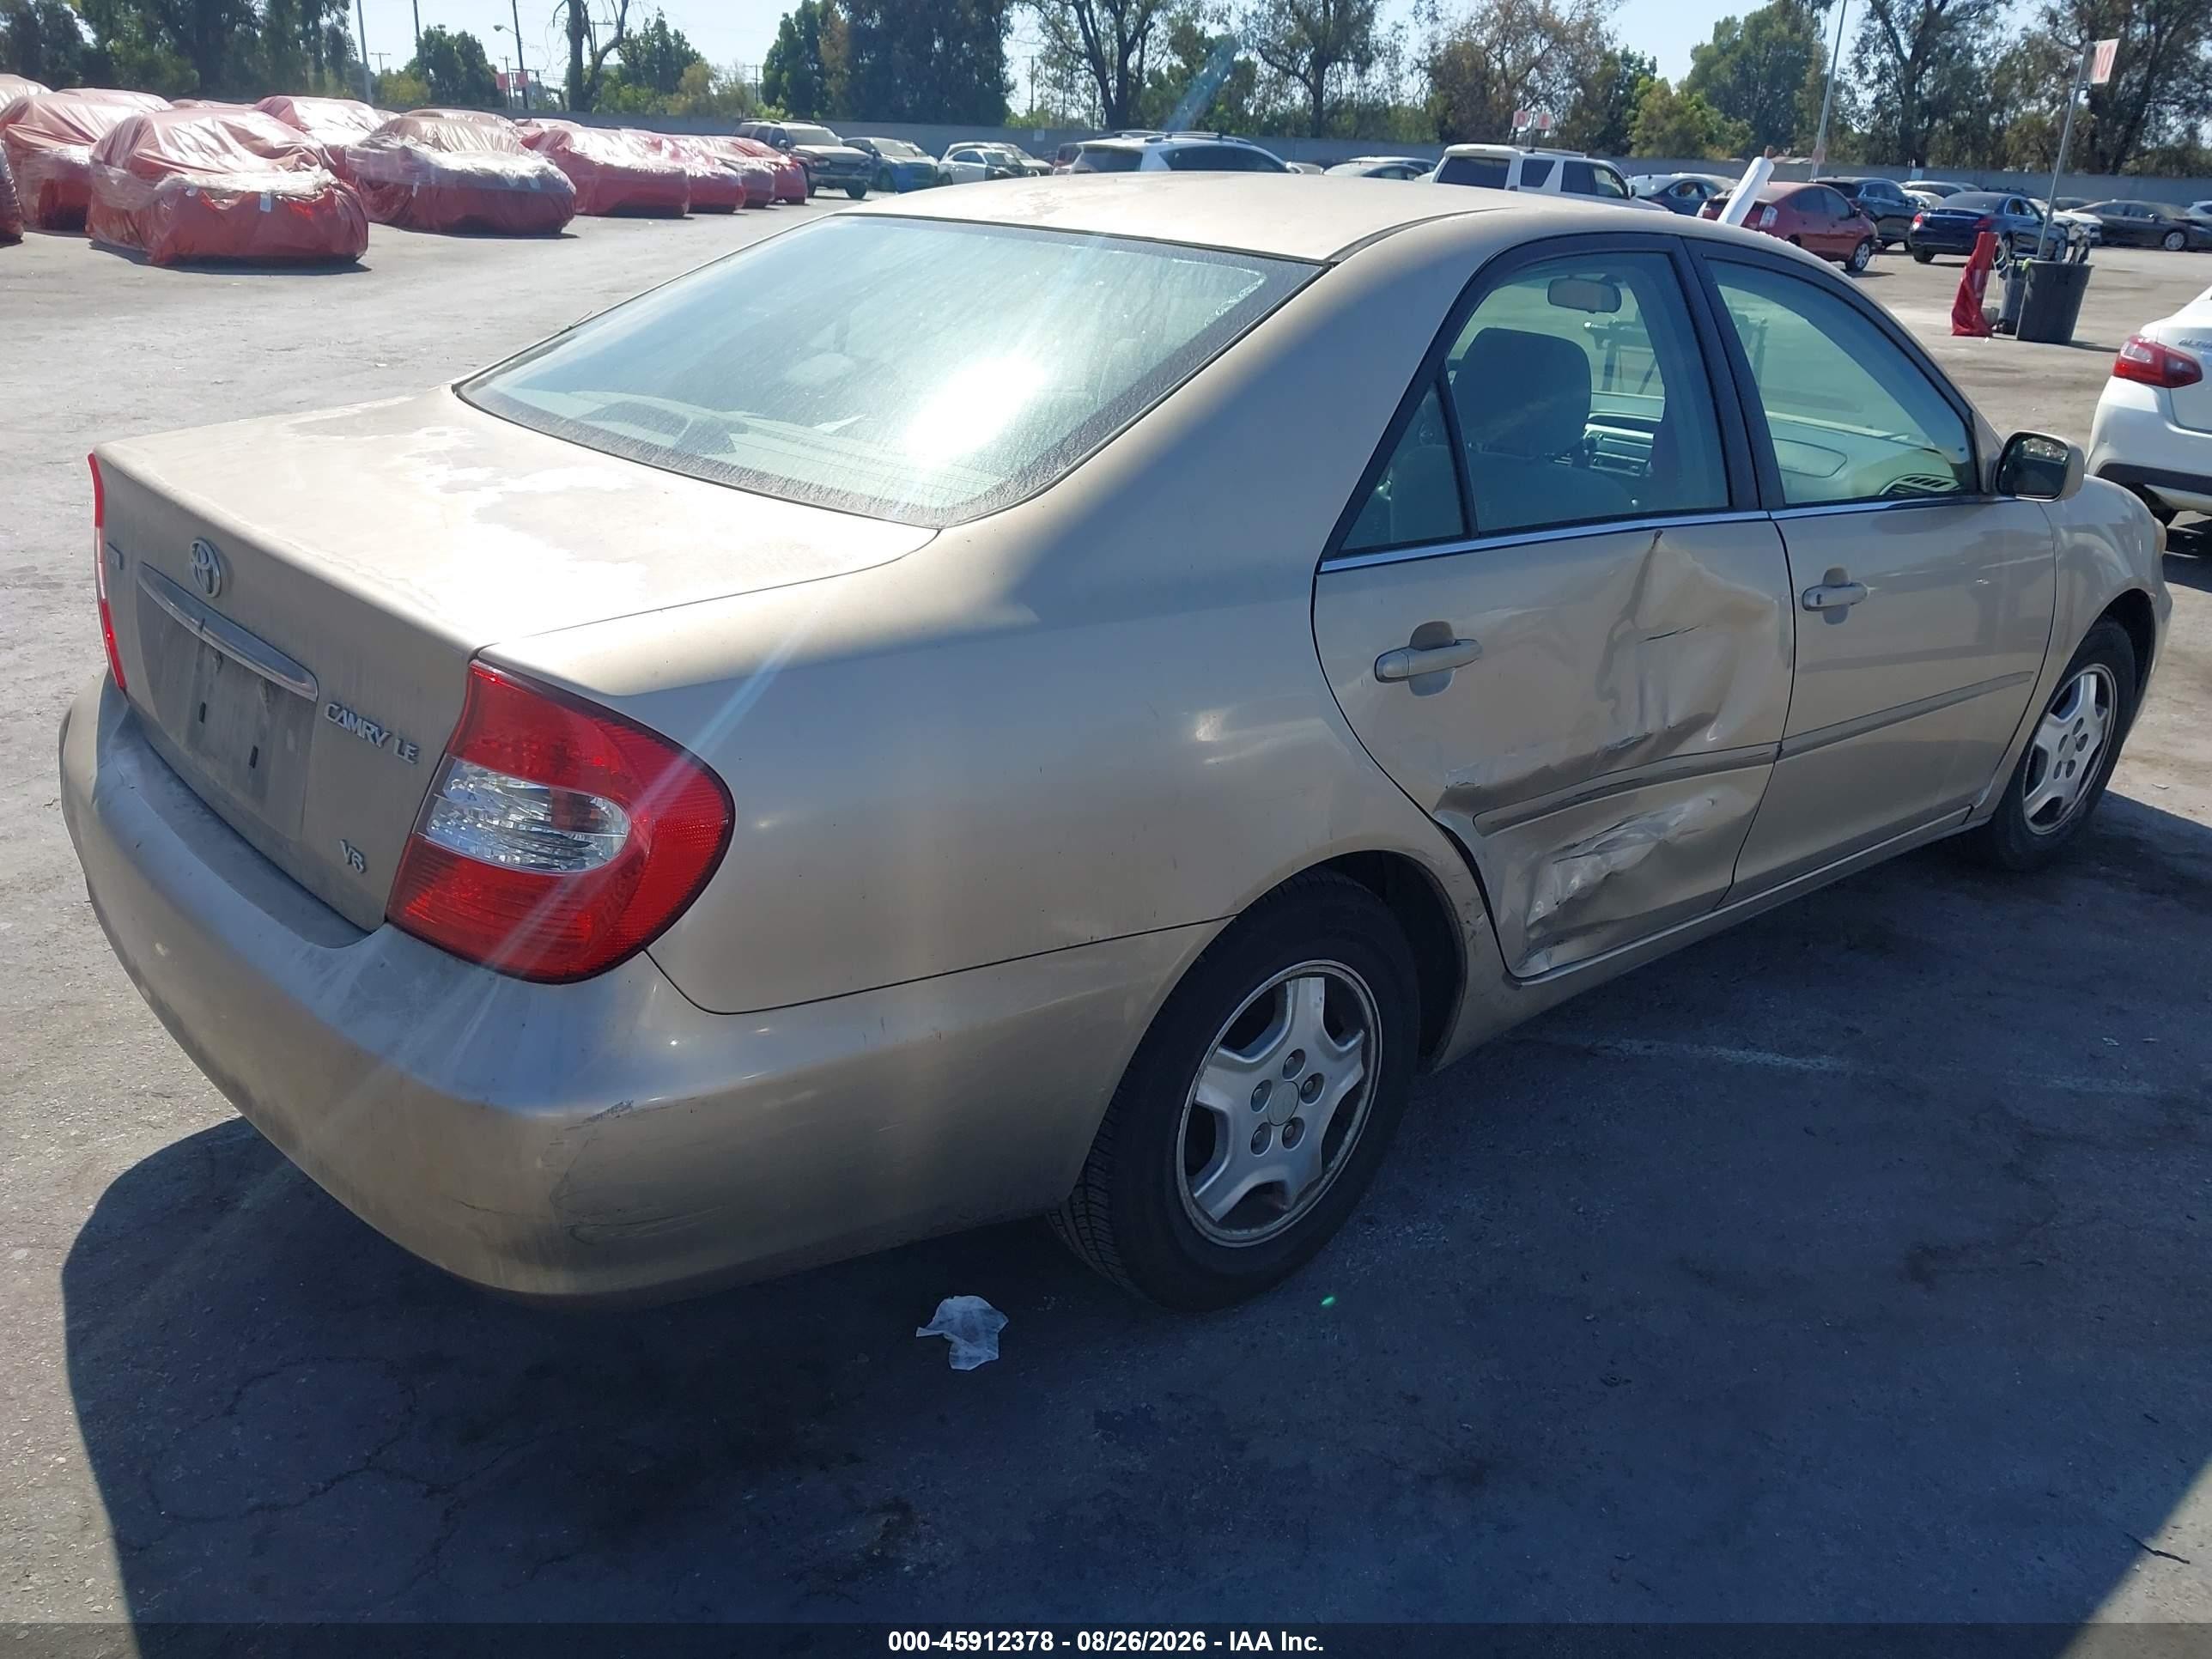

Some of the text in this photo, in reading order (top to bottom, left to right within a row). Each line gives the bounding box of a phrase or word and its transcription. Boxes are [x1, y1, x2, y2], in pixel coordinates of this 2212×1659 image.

[324, 702, 420, 764] CAMRY LE
[339, 839, 365, 873] V6
